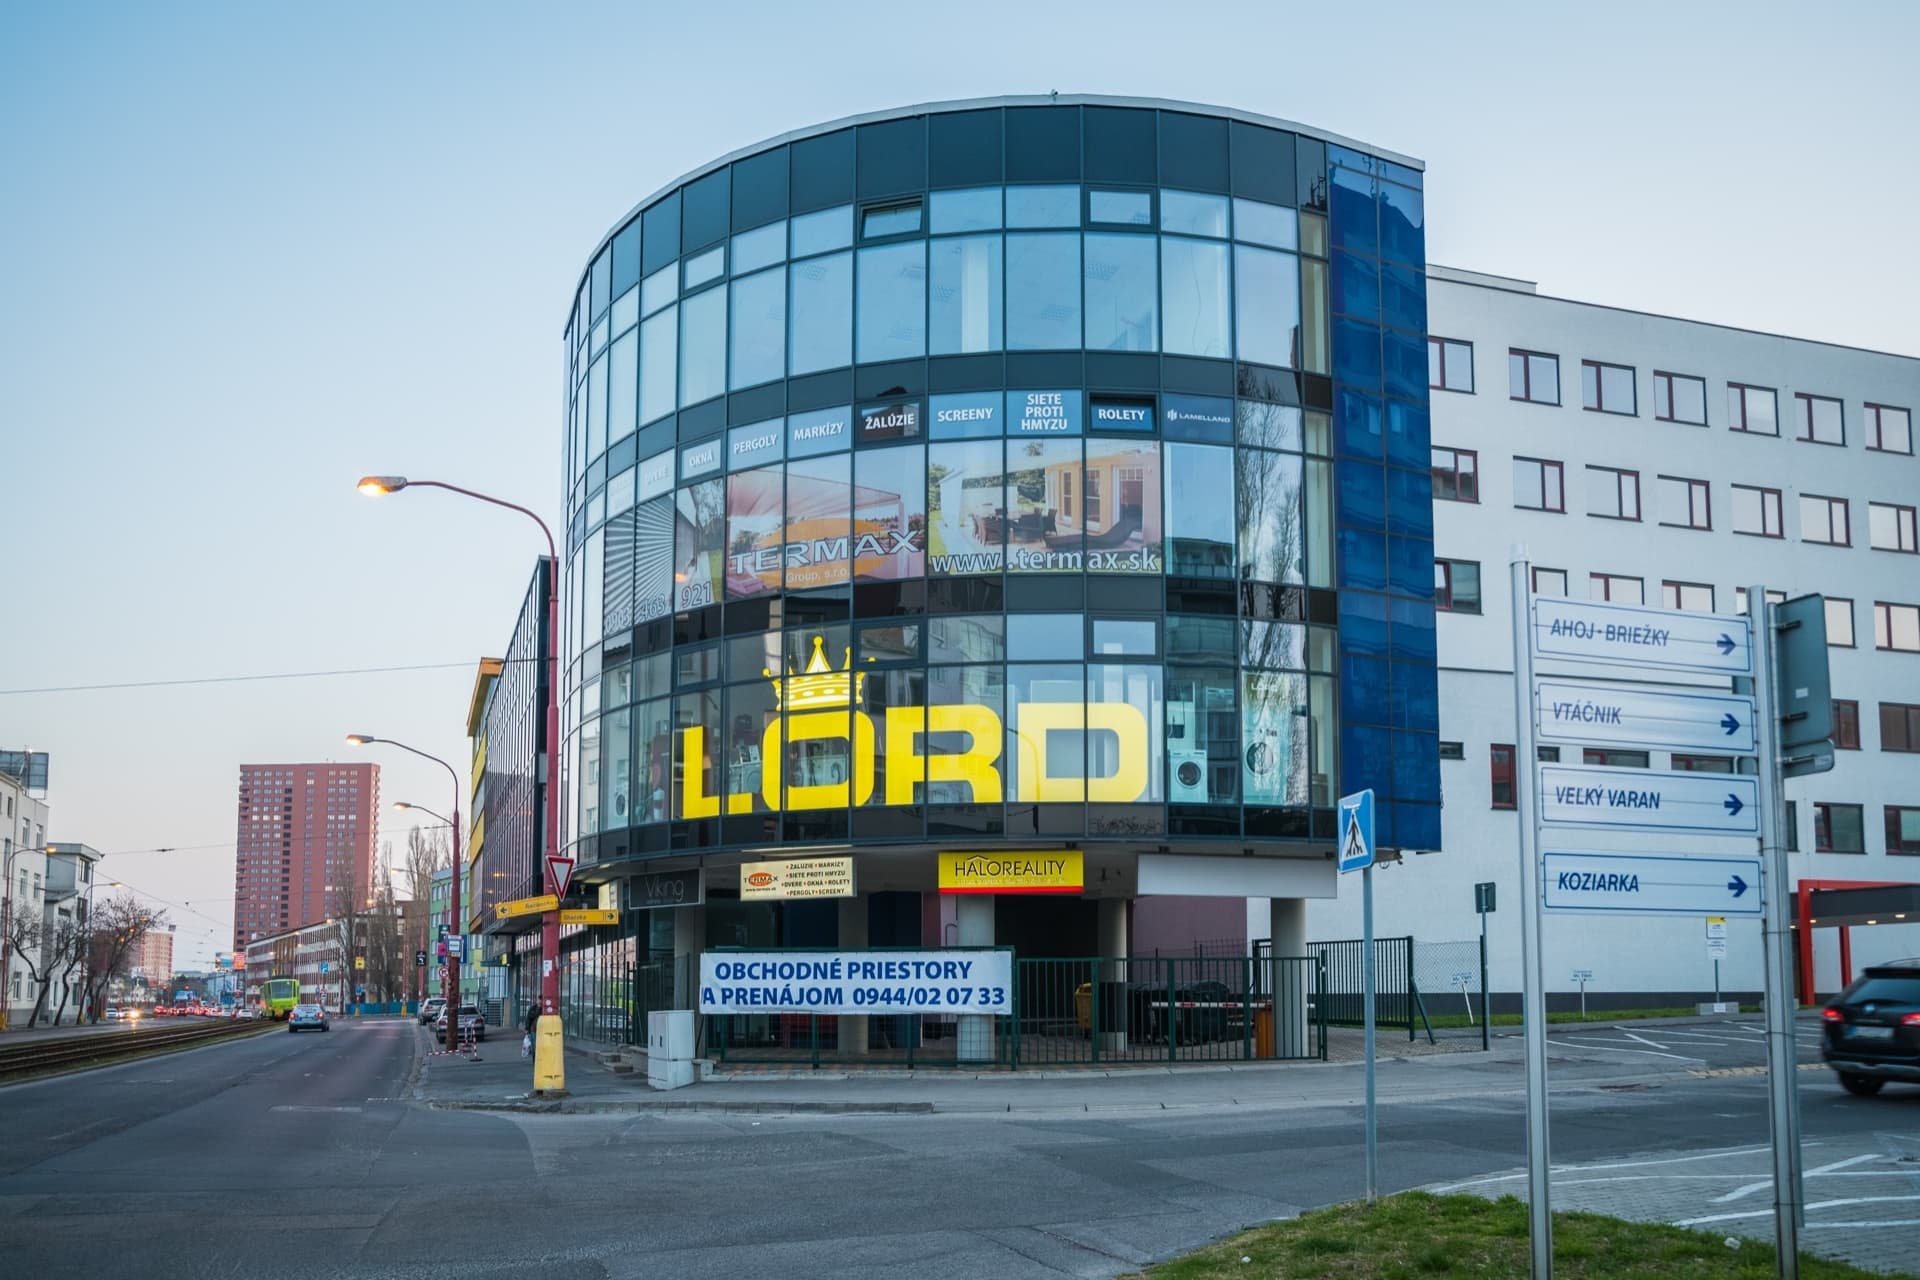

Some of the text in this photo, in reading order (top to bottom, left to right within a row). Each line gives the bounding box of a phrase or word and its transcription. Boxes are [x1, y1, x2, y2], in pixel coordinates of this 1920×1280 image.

[1027, 393, 1061, 405] SIETE
[865, 412, 915, 430] ŽALÚZIE
[937, 407, 993, 422] SCREENY
[1025, 406, 1063, 417] PROTI
[1098, 408, 1145, 421] ROLETY
[1178, 413, 1231, 424] LAMELLAND
[793, 422, 845, 441] MARKÍZY
[1021, 419, 1068, 431] HMYZU
[733, 434, 777, 454] PERGOLY
[729, 530, 922, 575] TERMAX
[930, 546, 1158, 574] www.termax.sk
[681, 581, 712, 609] 921
[1553, 699, 1621, 725] VTÁČNIK
[682, 702, 1148, 820] LORD
[1556, 784, 1661, 809] VEĽKÝ VARAN
[954, 858, 1066, 877] HALOREALITY
[1558, 872, 1639, 892] KOZIARKA
[715, 958, 973, 980] OBCHODNÉ PRIESTORY
[702, 983, 1005, 1006] A PRENÁJOM 0944/02 07 33
